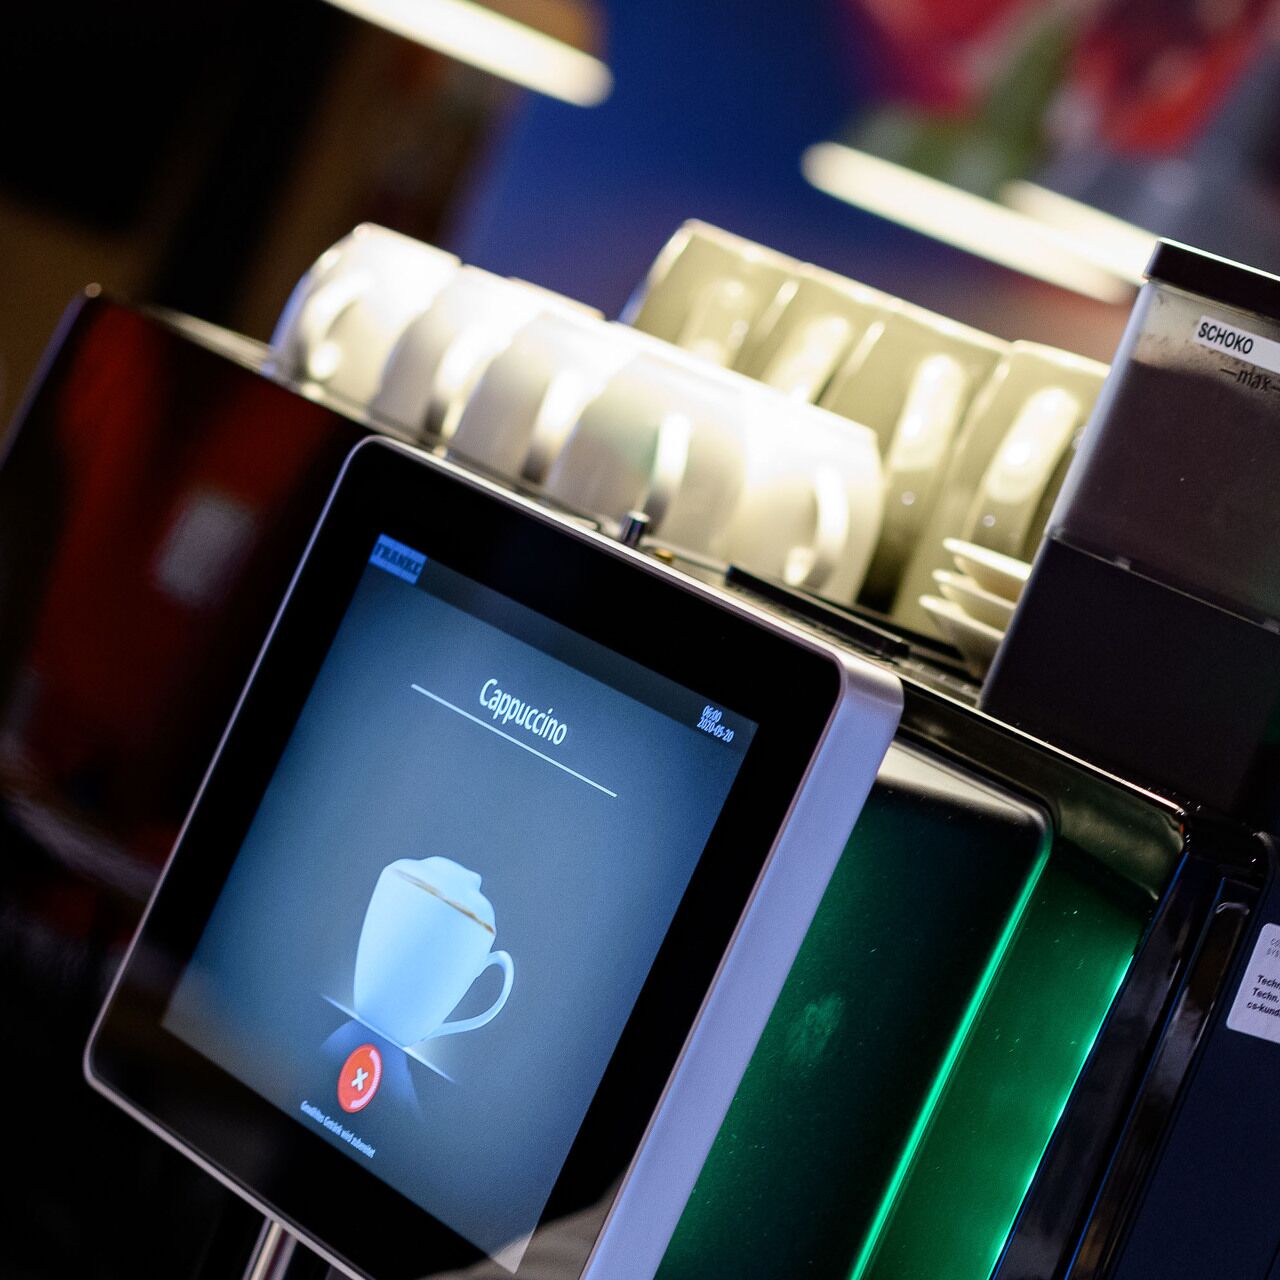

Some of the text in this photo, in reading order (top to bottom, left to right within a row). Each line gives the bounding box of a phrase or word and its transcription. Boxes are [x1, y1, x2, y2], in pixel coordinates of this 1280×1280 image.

[1198, 322, 1254, 354] SCHOKO
[1236, 368, 1273, 392] max
[479, 678, 568, 745] Cappuccino
[1252, 987, 1280, 1004] Techn.
